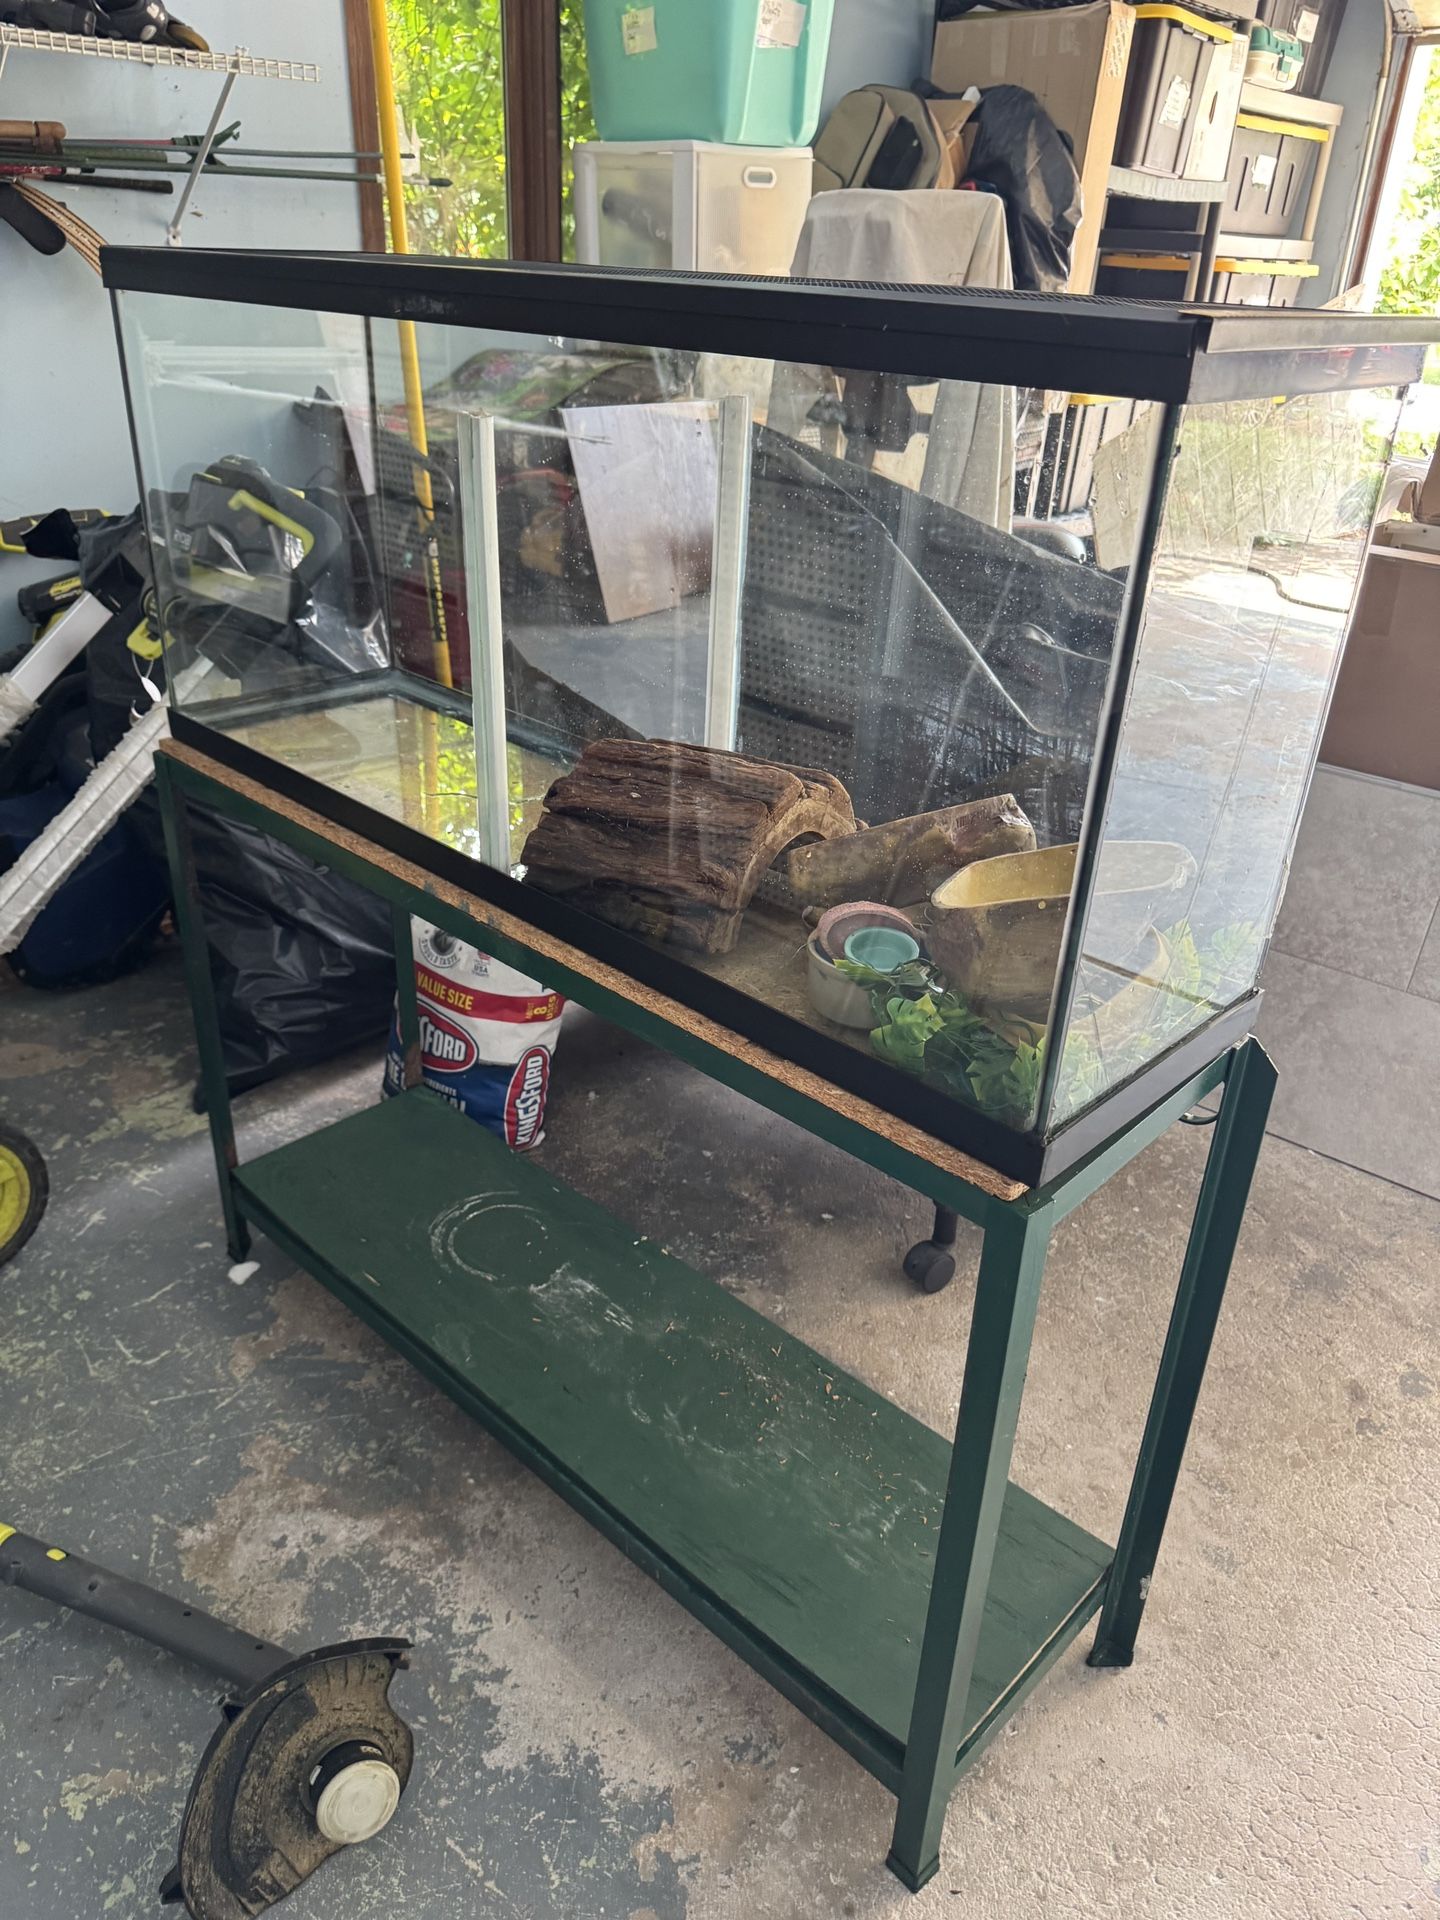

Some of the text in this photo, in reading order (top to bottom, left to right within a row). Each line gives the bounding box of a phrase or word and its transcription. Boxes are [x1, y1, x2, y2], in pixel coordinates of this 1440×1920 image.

[417, 970, 474, 1011] VALUE SIZE
[418, 1015, 467, 1062] SFORD
[515, 1055, 543, 1145] KINGSFORD
